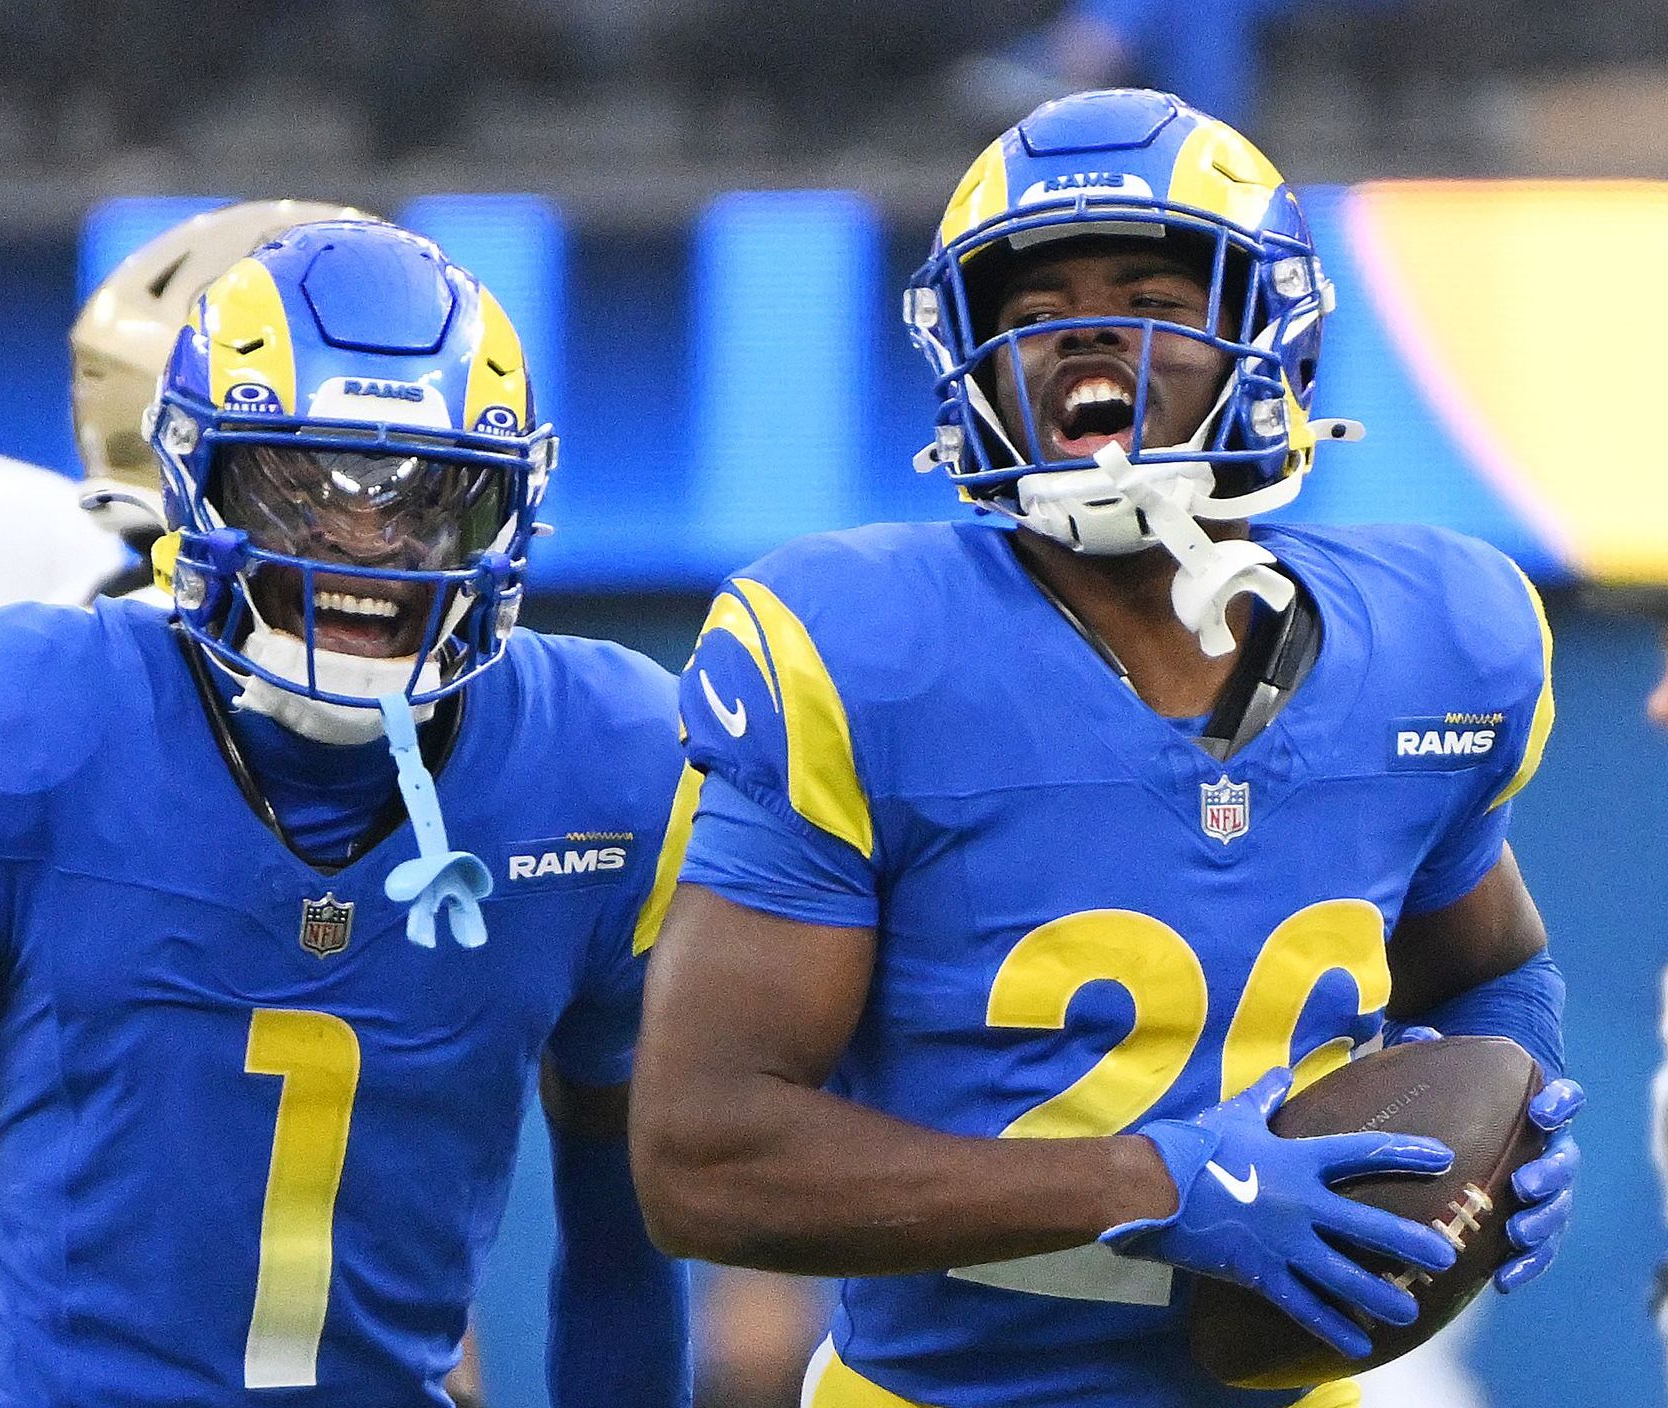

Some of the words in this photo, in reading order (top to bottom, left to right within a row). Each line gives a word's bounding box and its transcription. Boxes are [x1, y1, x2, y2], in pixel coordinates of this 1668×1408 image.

[1043, 171, 1124, 193] RAMS
[344, 380, 424, 402] RAMS
[224, 402, 278, 413] OAKLEY
[1396, 730, 1496, 756] RAMS
[1208, 807, 1241, 832] NFL
[509, 847, 627, 880] RAMS
[306, 923, 345, 948] NFL
[1357, 1083, 1431, 1132] NATIONA
[243, 1007, 361, 1390] 1
